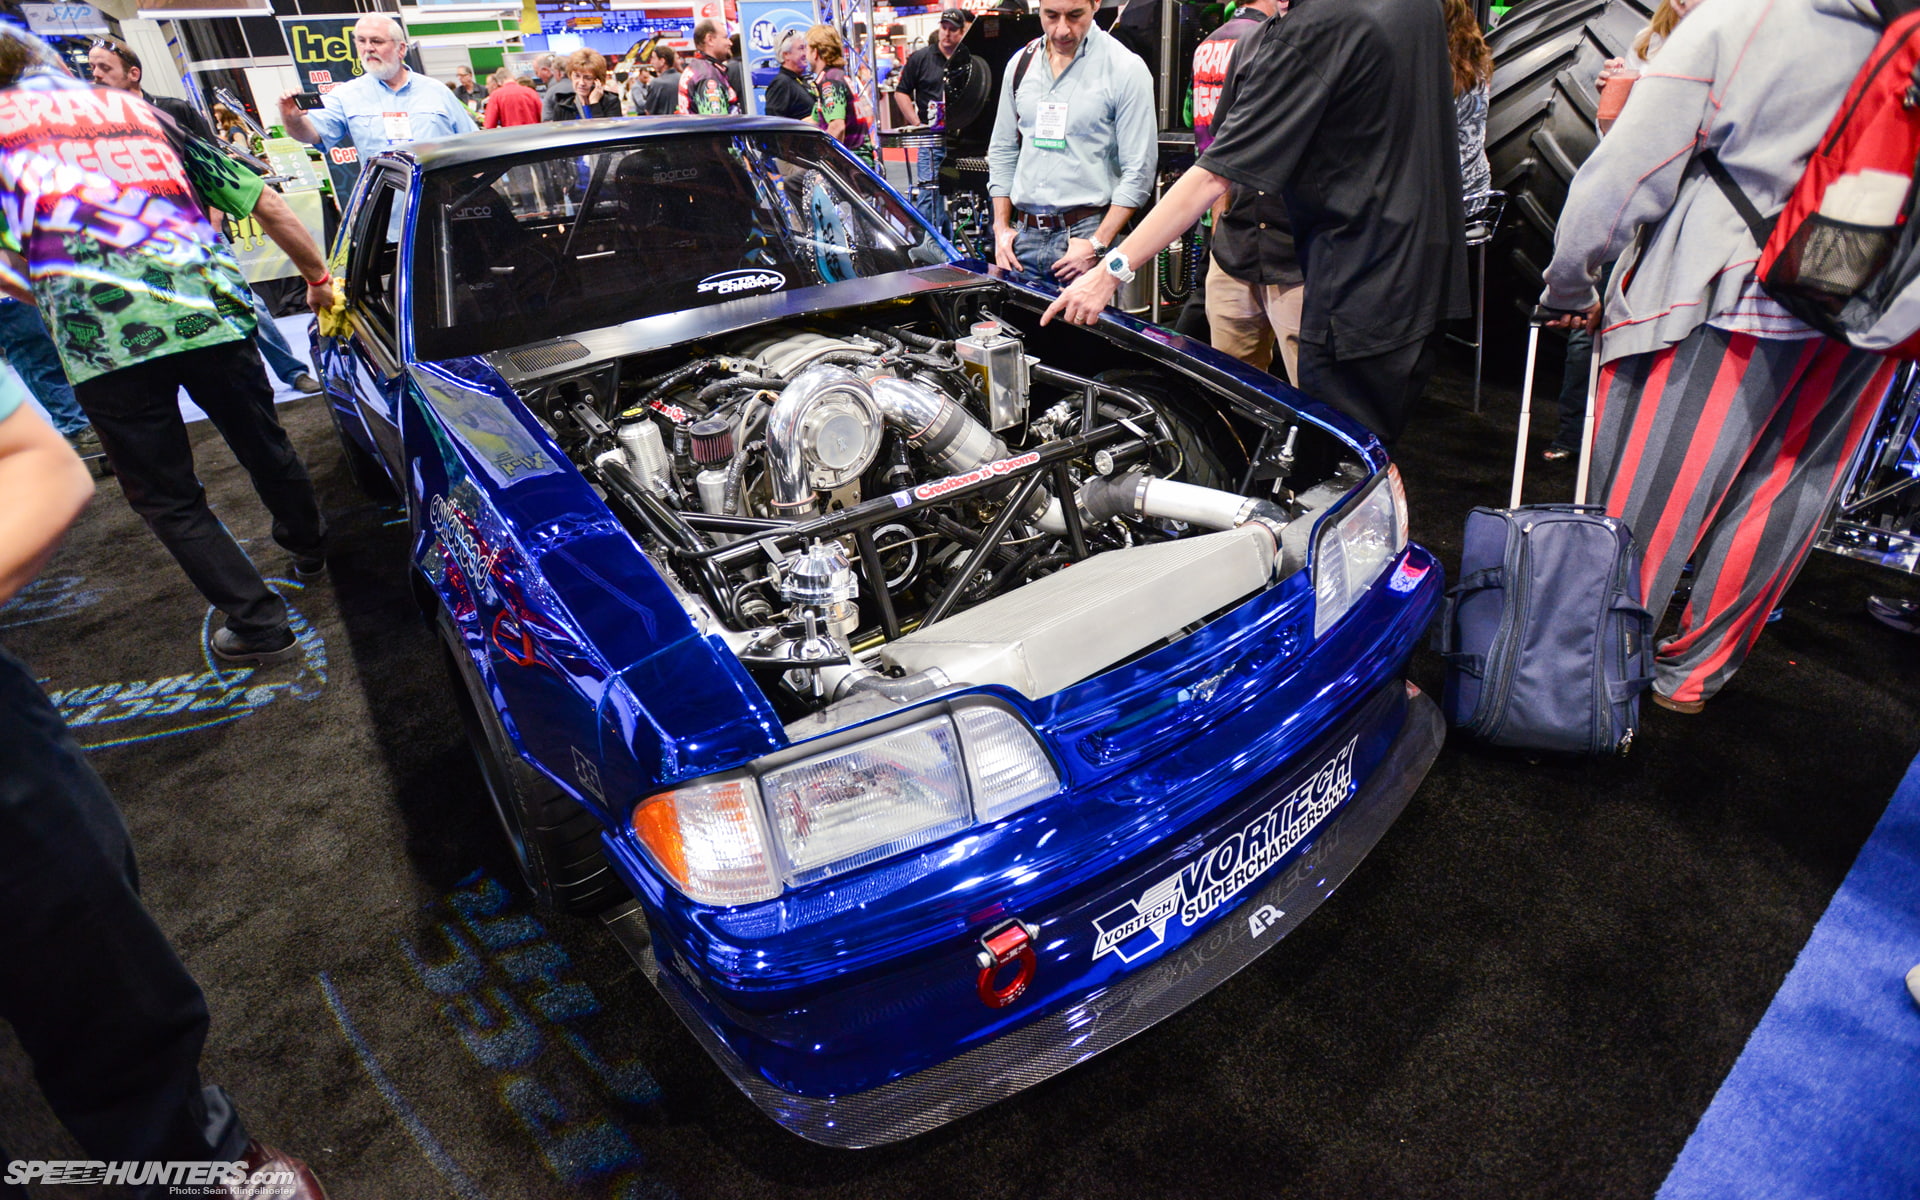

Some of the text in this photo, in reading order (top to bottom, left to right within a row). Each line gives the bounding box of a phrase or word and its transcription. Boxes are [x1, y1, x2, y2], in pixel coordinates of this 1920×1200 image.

[456, 206, 491, 217] arco
[916, 473, 980, 498] Creations
[991, 453, 1039, 473] Chrome
[1178, 734, 1359, 901] VORTECH
[1181, 801, 1325, 927] SUPERCHARGERS
[1103, 901, 1172, 945] VORTECH
